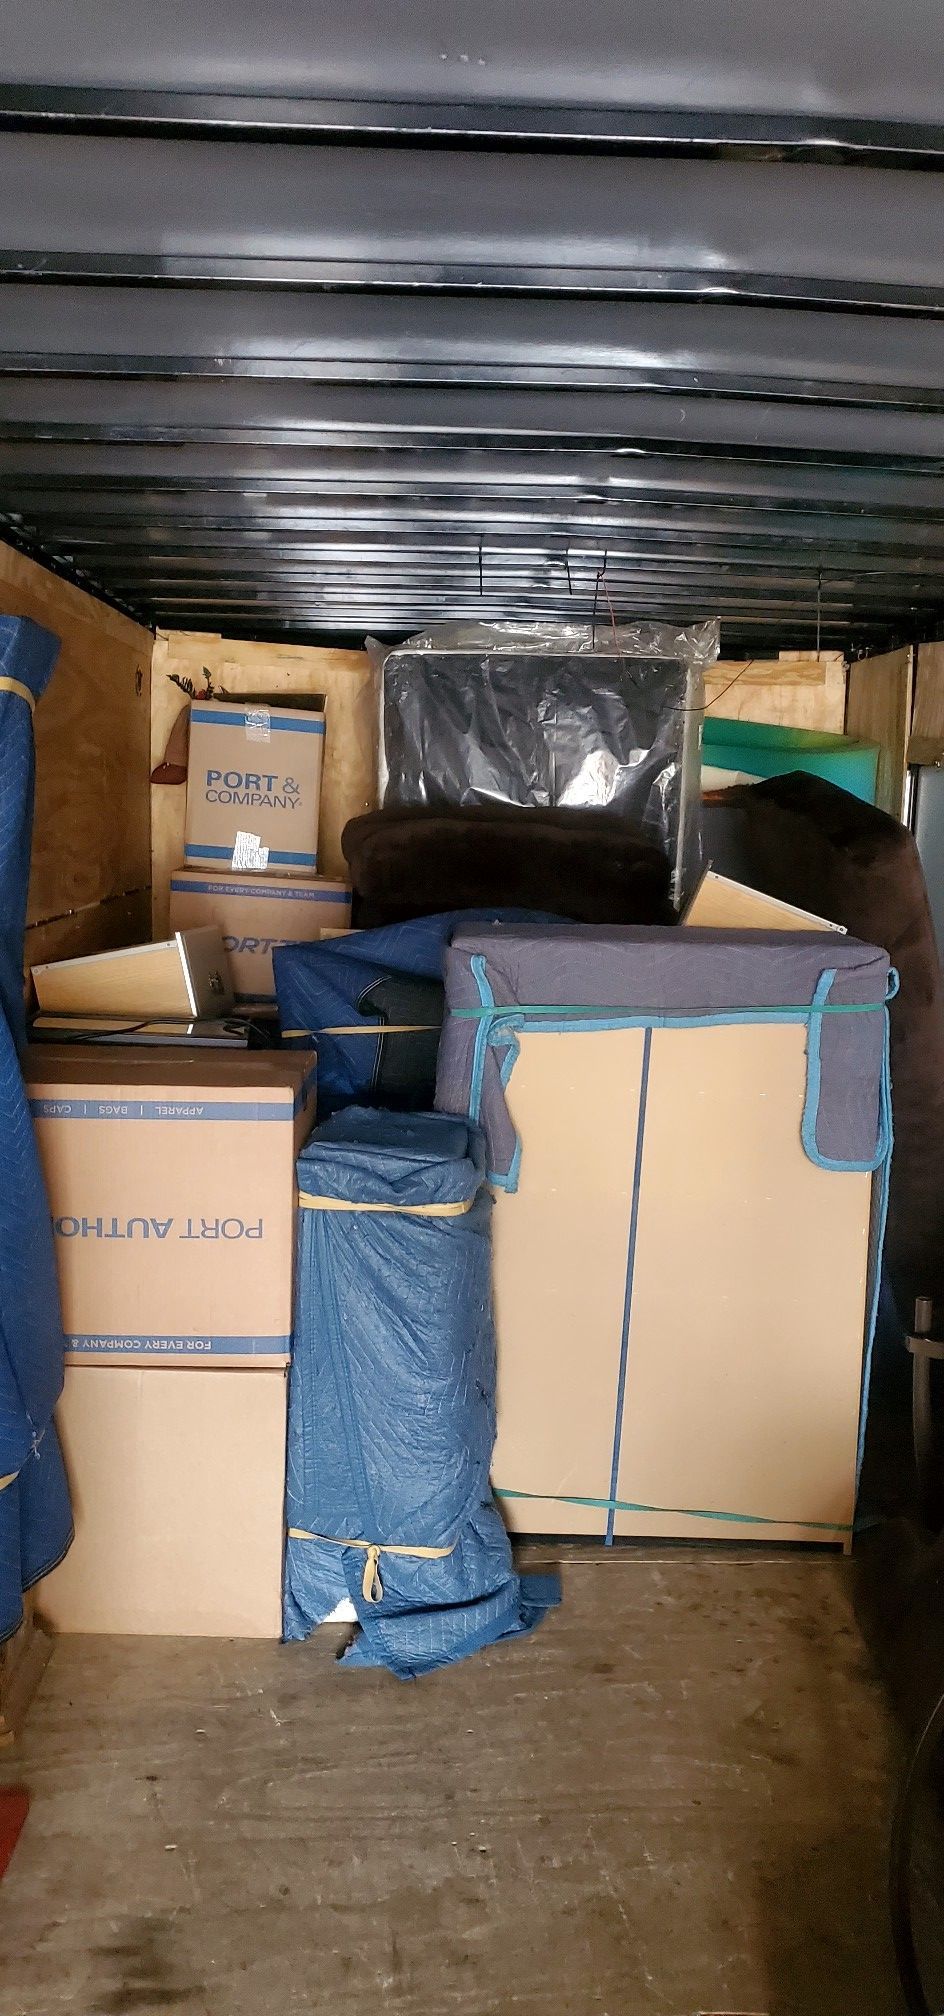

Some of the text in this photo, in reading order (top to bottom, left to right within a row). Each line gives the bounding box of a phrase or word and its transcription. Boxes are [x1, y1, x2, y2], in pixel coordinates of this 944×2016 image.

[206, 769, 301, 795] PORT &
[205, 789, 301, 809] COMPANY
[208, 884, 224, 892] FOR
[225, 886, 249, 895] EVERY
[250, 888, 287, 897] COMPANY
[295, 890, 315, 898] TEAM
[43, 1104, 72, 1114] CAPS
[98, 1104, 128, 1115] BAGS
[155, 1105, 204, 1116] APPAREL
[54, 1216, 263, 1240] PORT AUTHO
[71, 1339, 80, 1348] &
[83, 1339, 141, 1349] COMPANY
[145, 1340, 184, 1350] EVERY
[186, 1340, 212, 1350] FOR
